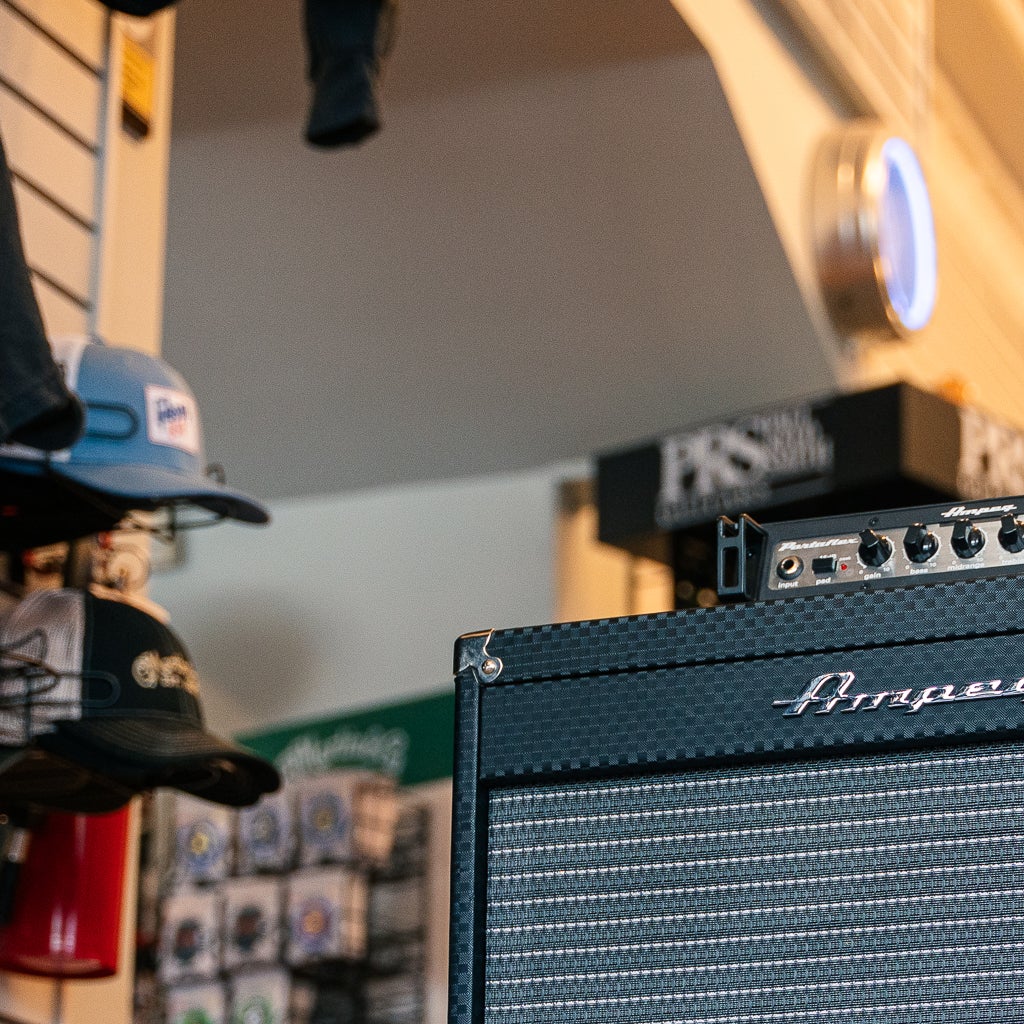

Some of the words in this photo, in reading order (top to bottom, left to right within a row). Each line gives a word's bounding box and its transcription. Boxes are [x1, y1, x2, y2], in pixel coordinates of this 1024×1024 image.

[941, 504, 1017, 517] Ampeg
[778, 538, 858, 551] Portaflex
[947, 562, 985, 571] midrange
[815, 577, 832, 585] pad
[864, 572, 882, 581] gain
[778, 581, 799, 589] input
